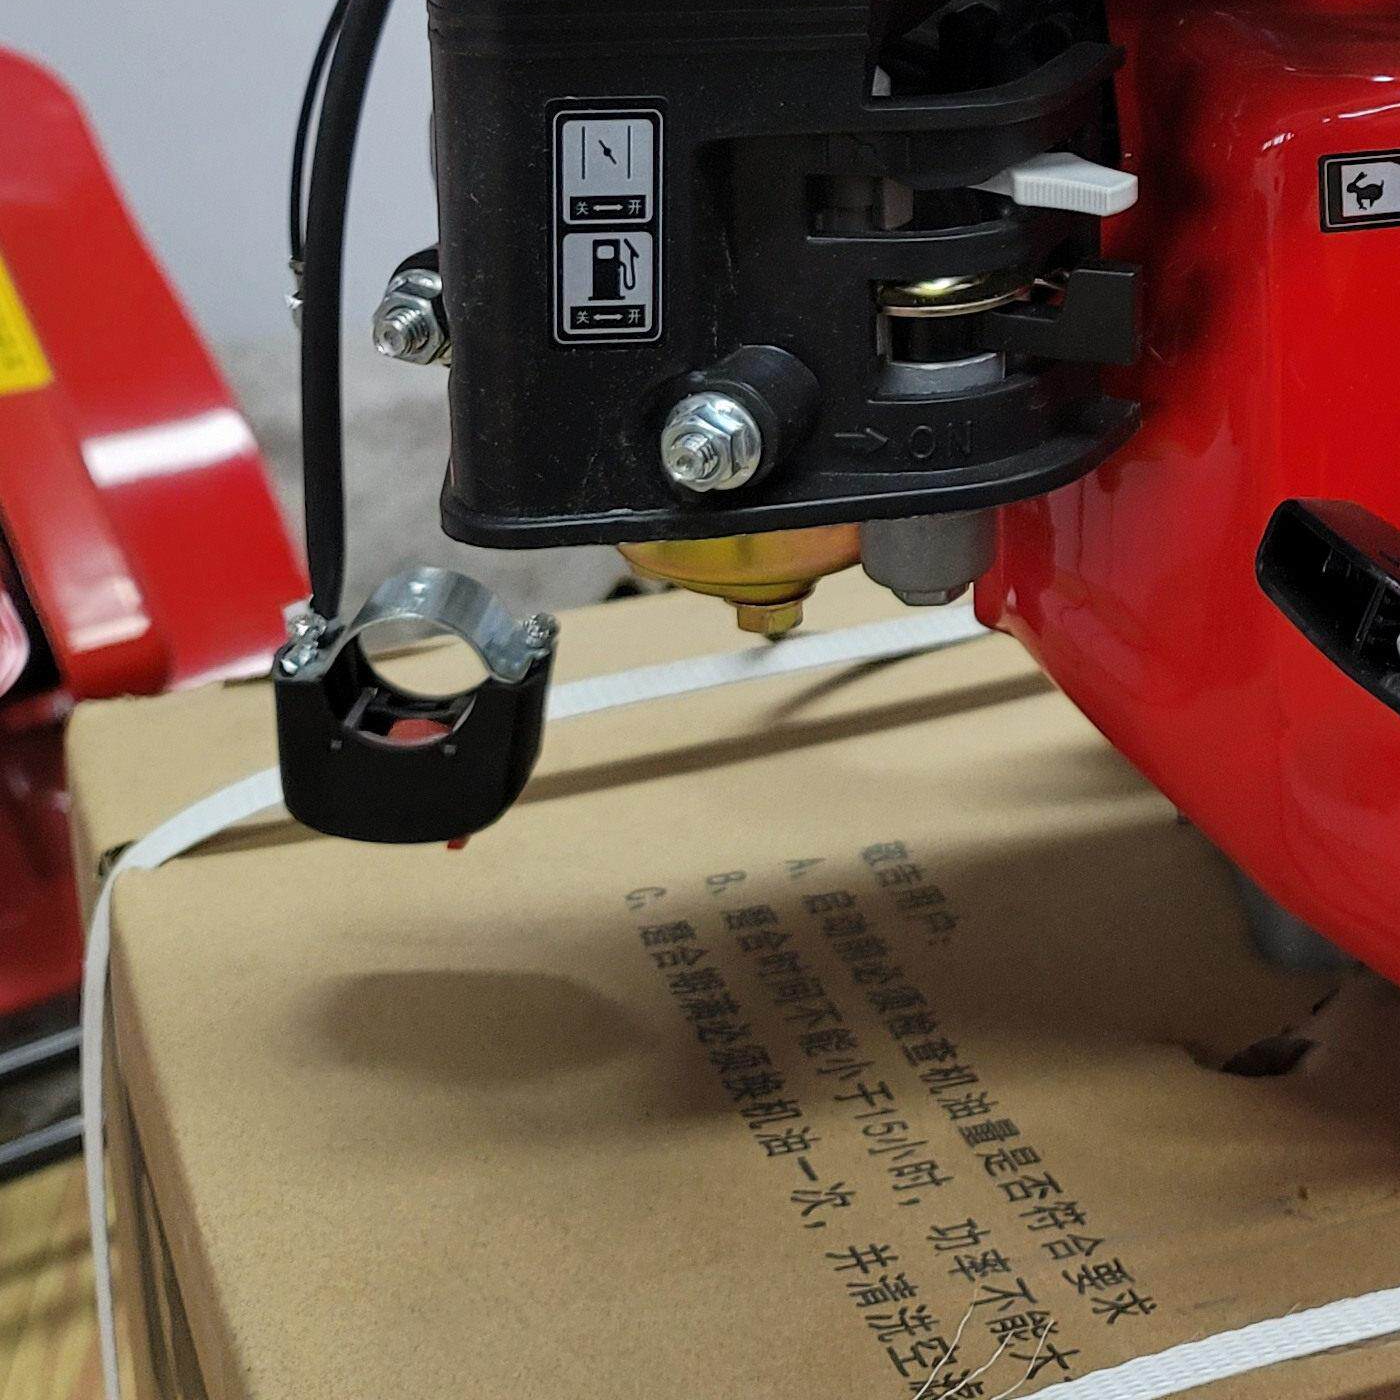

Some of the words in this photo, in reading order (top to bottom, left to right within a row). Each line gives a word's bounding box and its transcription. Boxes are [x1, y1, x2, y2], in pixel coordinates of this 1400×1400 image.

[576, 202, 589, 215] 关
[628, 200, 641, 215] 开
[576, 310, 589, 324] 关
[628, 309, 641, 324] 开
[908, 420, 973, 459] ON
